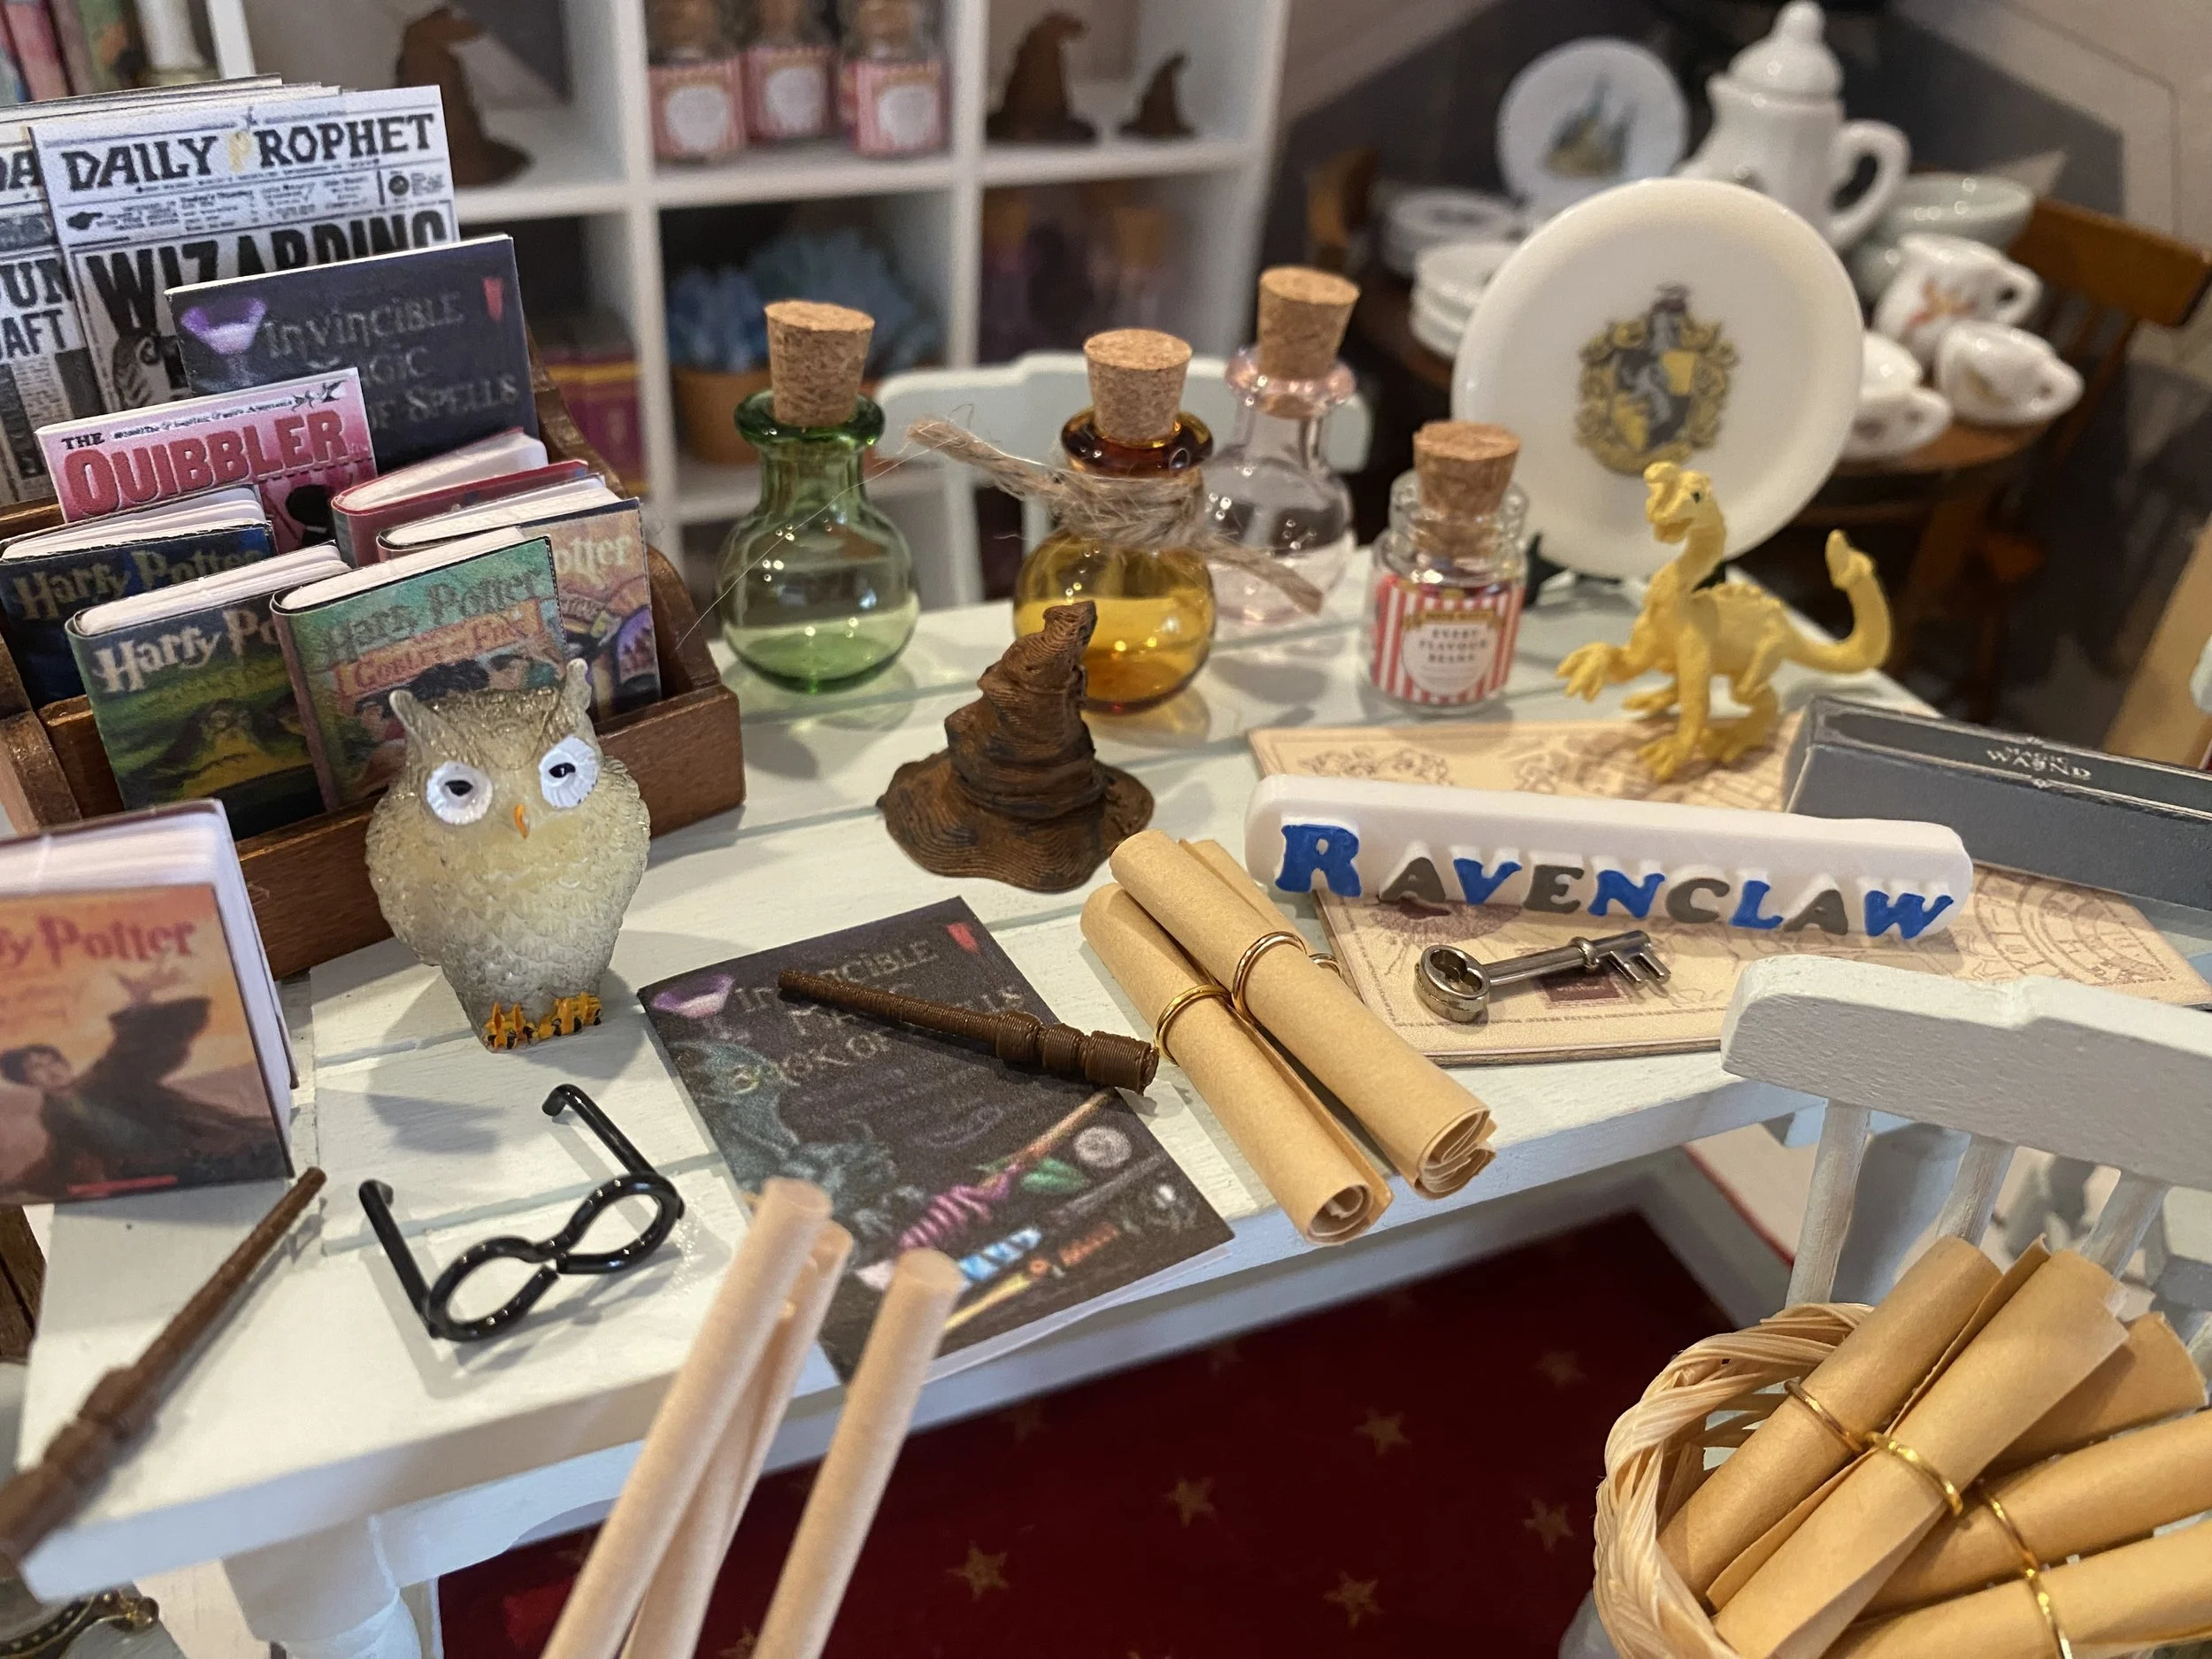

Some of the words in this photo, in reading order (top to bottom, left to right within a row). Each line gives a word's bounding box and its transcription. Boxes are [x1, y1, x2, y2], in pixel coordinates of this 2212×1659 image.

[60, 135, 218, 192] DAILY
[227, 113, 434, 173] PROPHET
[61, 432, 105, 449] THE
[63, 411, 349, 516] QUIBBLER
[13, 563, 129, 619] Harry
[553, 535, 632, 591] otter
[426, 569, 542, 619] Potter
[92, 626, 222, 693] Harry
[1275, 821, 1955, 941] RAVENCLAW
[36, 915, 197, 967] Potter
